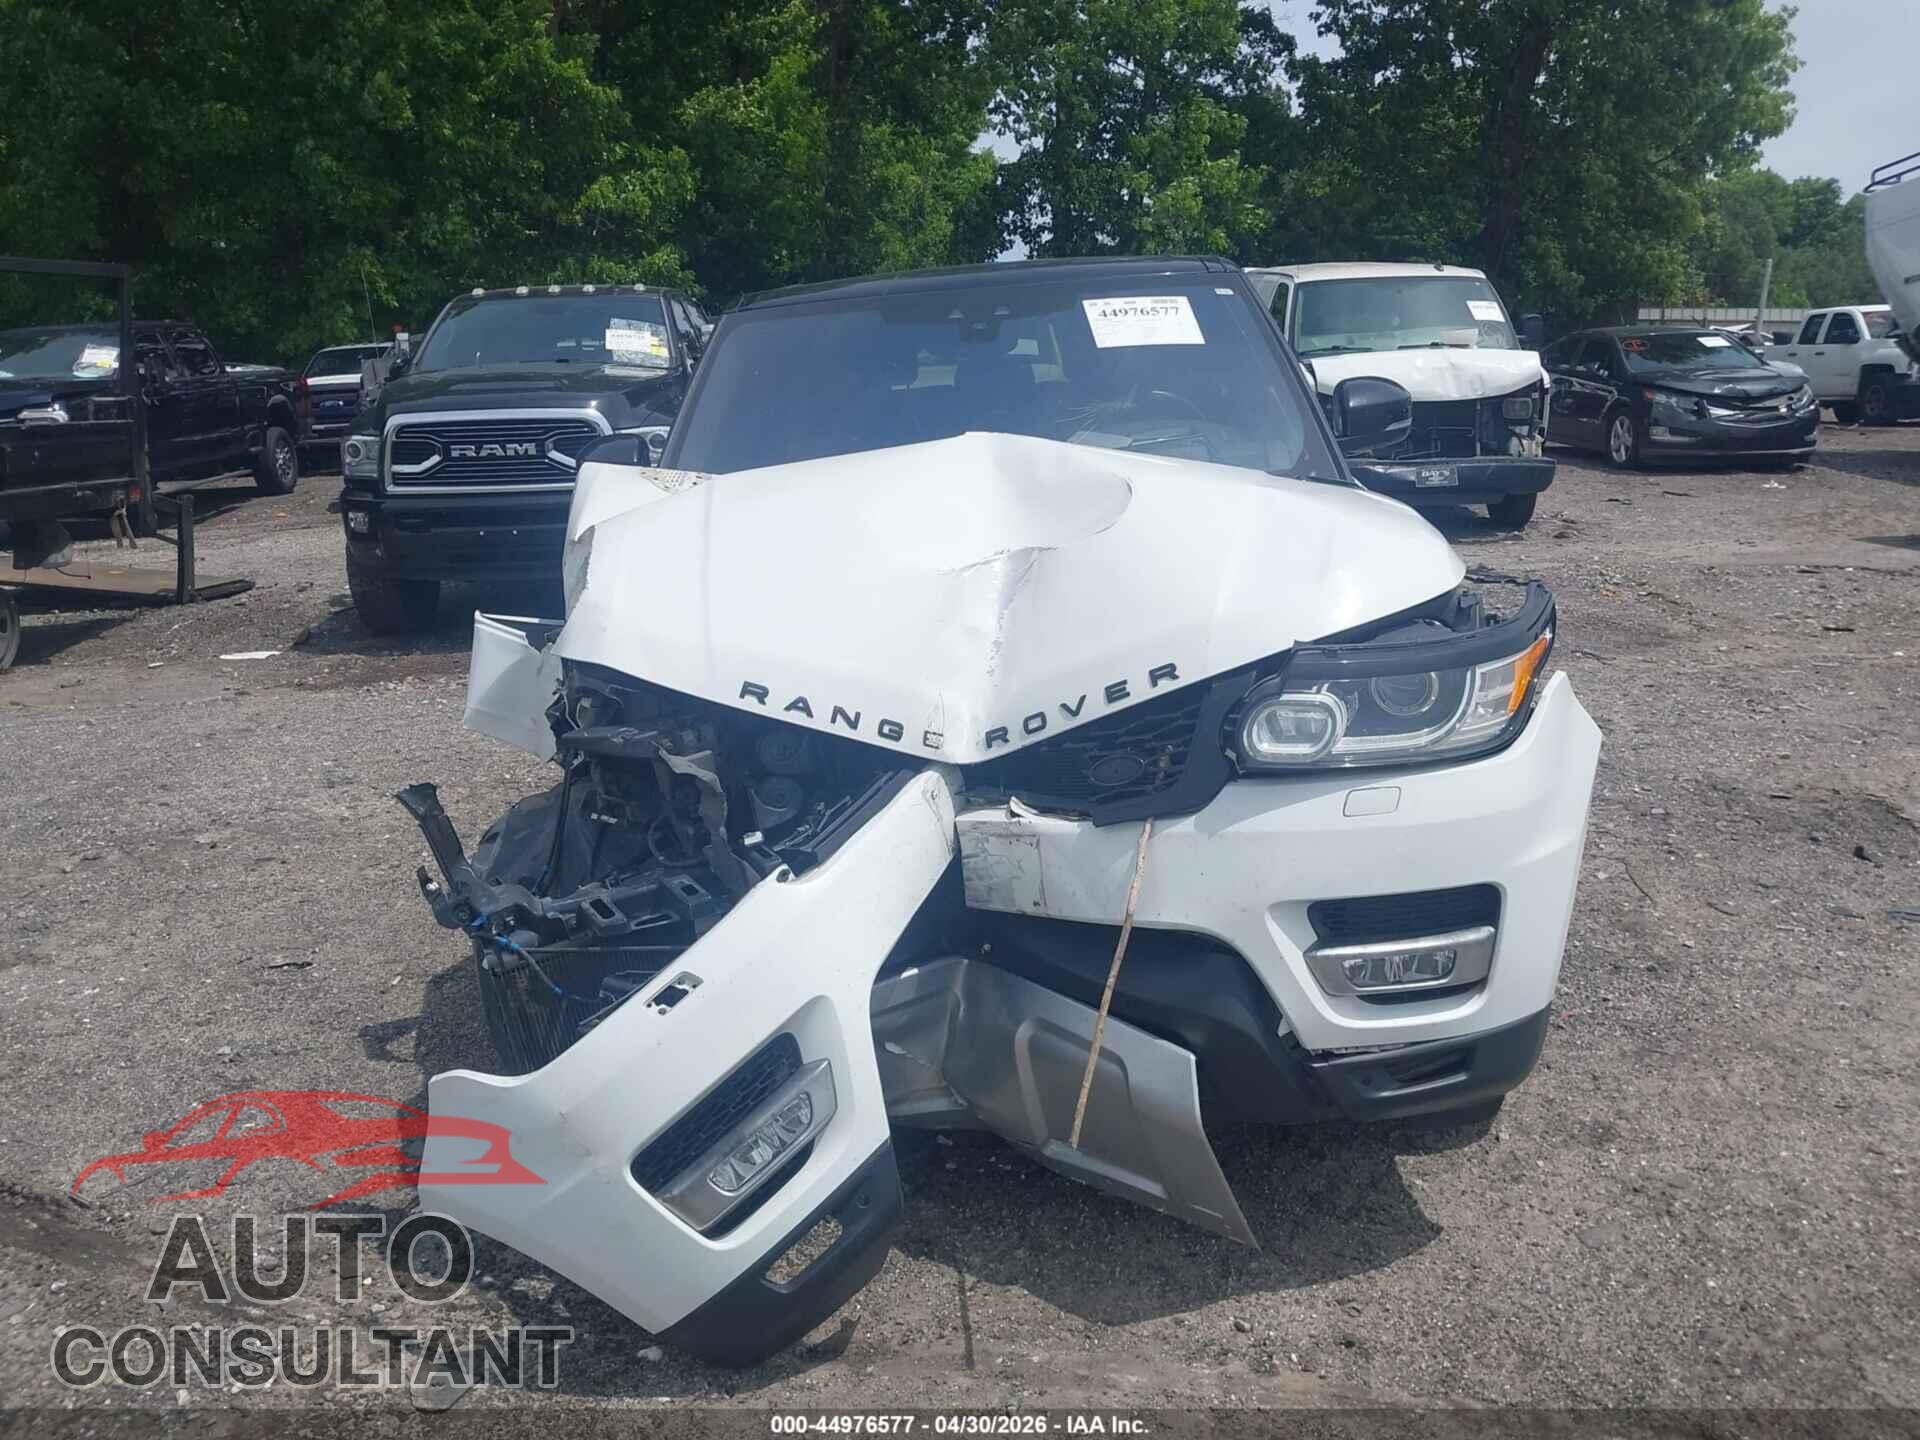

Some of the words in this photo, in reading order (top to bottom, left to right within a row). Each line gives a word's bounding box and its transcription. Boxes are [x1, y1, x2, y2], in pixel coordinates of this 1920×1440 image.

[1098, 306, 1180, 318] 44976577
[450, 442, 537, 457] RAM
[738, 680, 945, 750] RANGE
[984, 662, 1181, 750] ROVER
